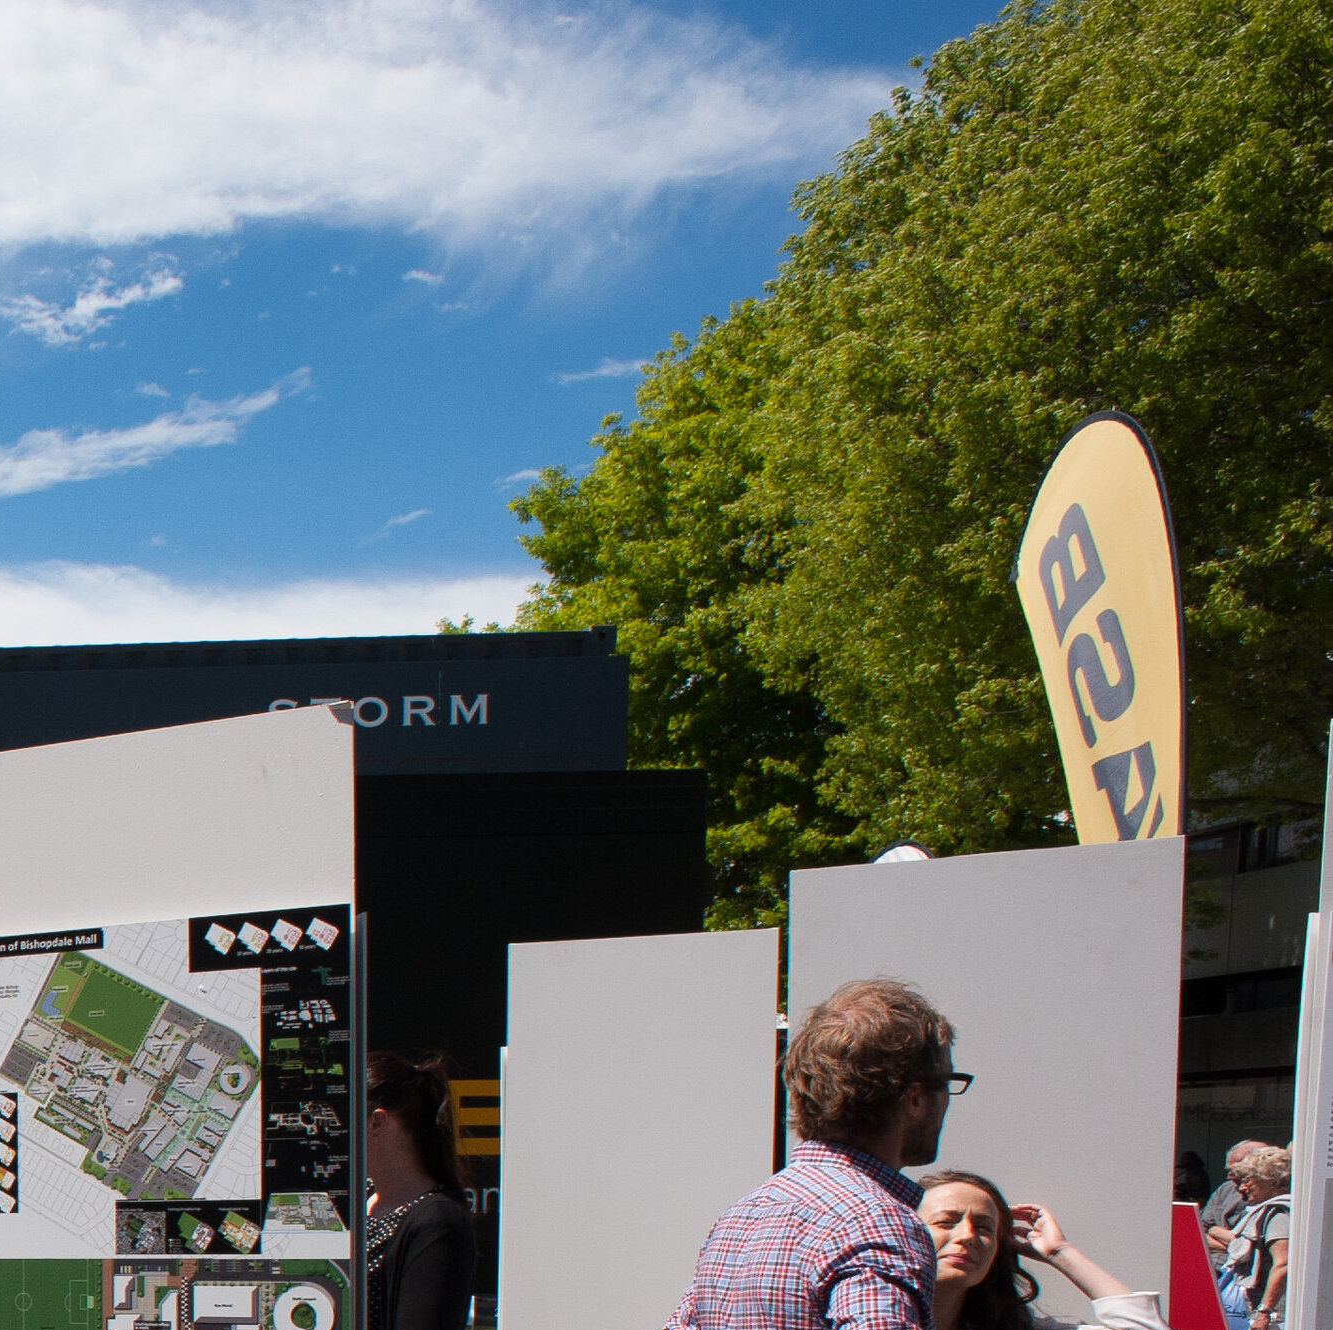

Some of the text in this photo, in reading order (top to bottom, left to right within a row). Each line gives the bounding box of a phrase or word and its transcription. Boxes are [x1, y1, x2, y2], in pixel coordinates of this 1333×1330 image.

[268, 693, 489, 728] ORM
[7, 939, 19, 953] of
[20, 935, 73, 951] Bishopdale
[75, 933, 97, 946] Mall
[1257, 1106, 1296, 1122] COS
